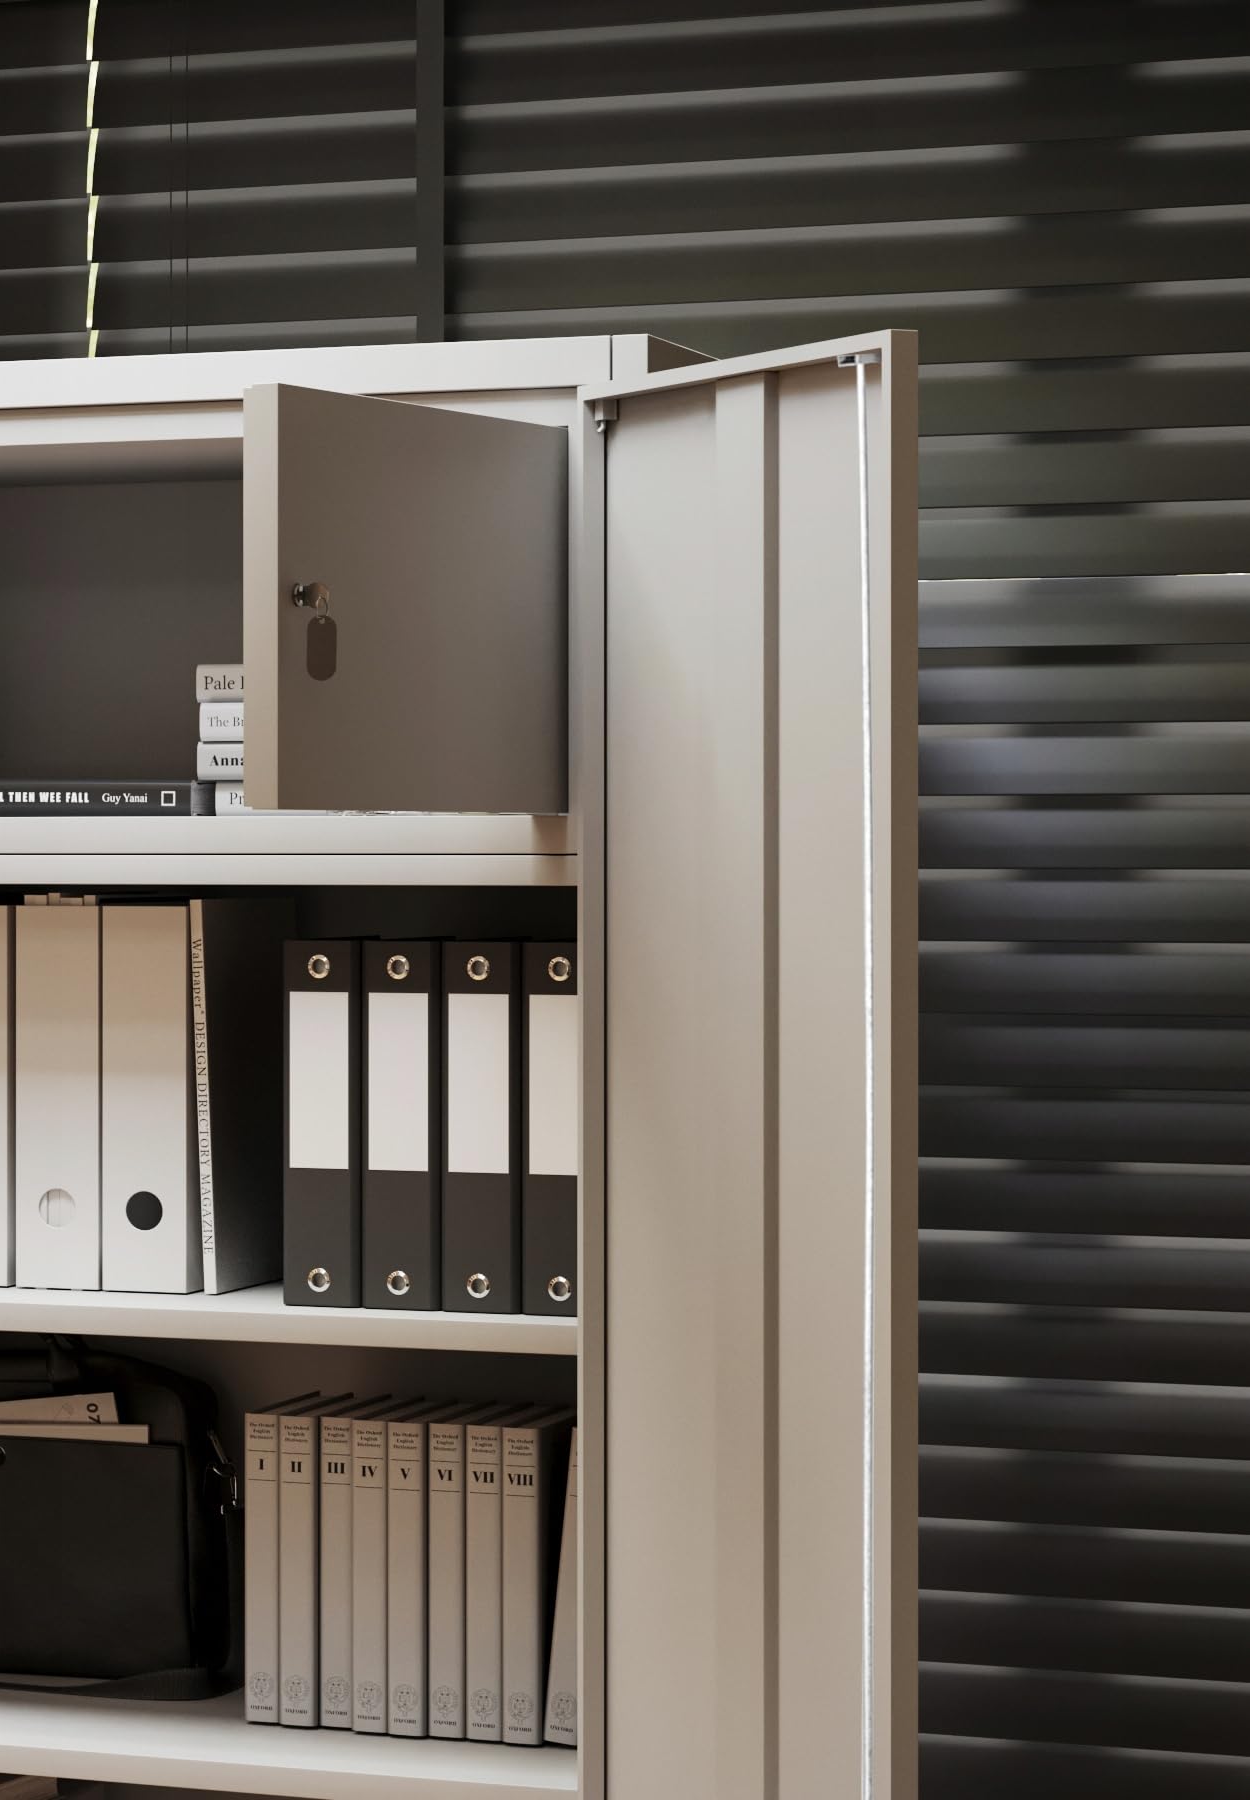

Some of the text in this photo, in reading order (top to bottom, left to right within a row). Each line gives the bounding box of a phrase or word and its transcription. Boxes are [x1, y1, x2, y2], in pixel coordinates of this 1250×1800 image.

[204, 675, 235, 690] Pale
[207, 715, 229, 727] The
[8, 791, 36, 803] THEN
[39, 791, 62, 803] WEE
[65, 792, 90, 803] FALL
[101, 792, 121, 805] Guy
[123, 793, 148, 803] Yanai
[195, 1022, 207, 1077] DESIGN
[197, 1083, 211, 1167] DIRECTORY
[201, 1174, 214, 1255] MAGAZINE
[259, 1458, 264, 1470] I
[291, 1461, 302, 1473] II
[327, 1461, 345, 1474] III
[361, 1465, 378, 1478] IV
[400, 1467, 410, 1480] V
[437, 1469, 453, 1482] VI
[472, 1470, 495, 1484] VII
[508, 1473, 534, 1486] VIII
